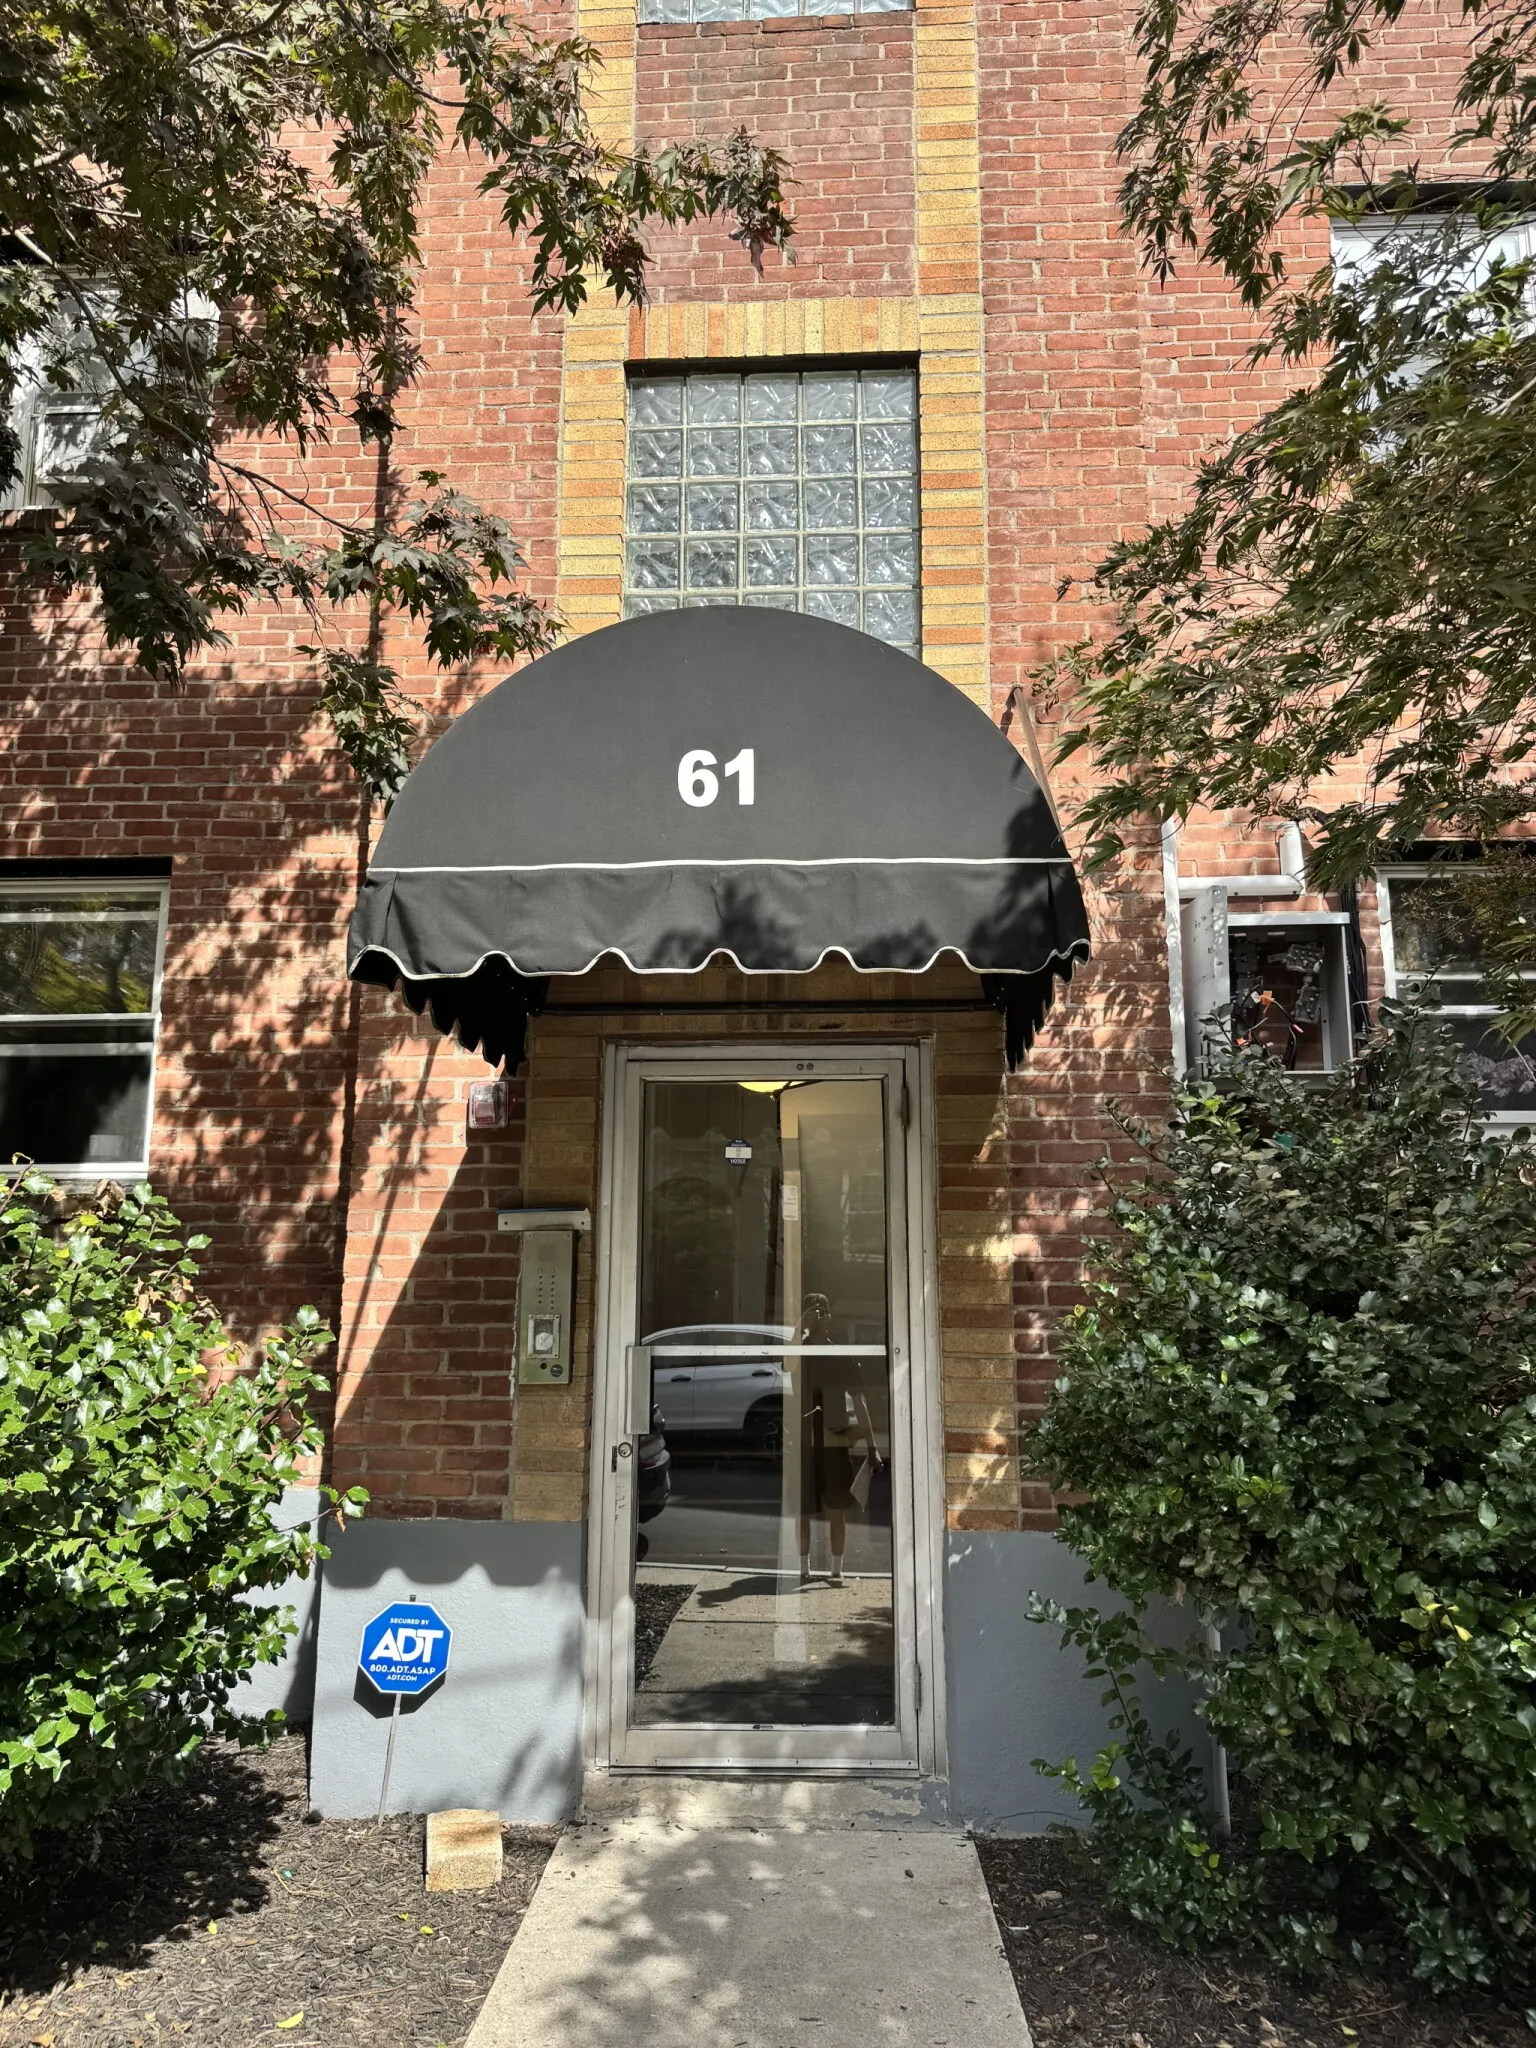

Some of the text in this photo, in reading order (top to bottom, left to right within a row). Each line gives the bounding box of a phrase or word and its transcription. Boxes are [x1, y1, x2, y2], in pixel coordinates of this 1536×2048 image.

[677, 748, 754, 808] 61
[390, 1617, 420, 1625] SECURED
[368, 1627, 444, 1663] ADT
[370, 1664, 436, 1674] 800.ADT.ASAP
